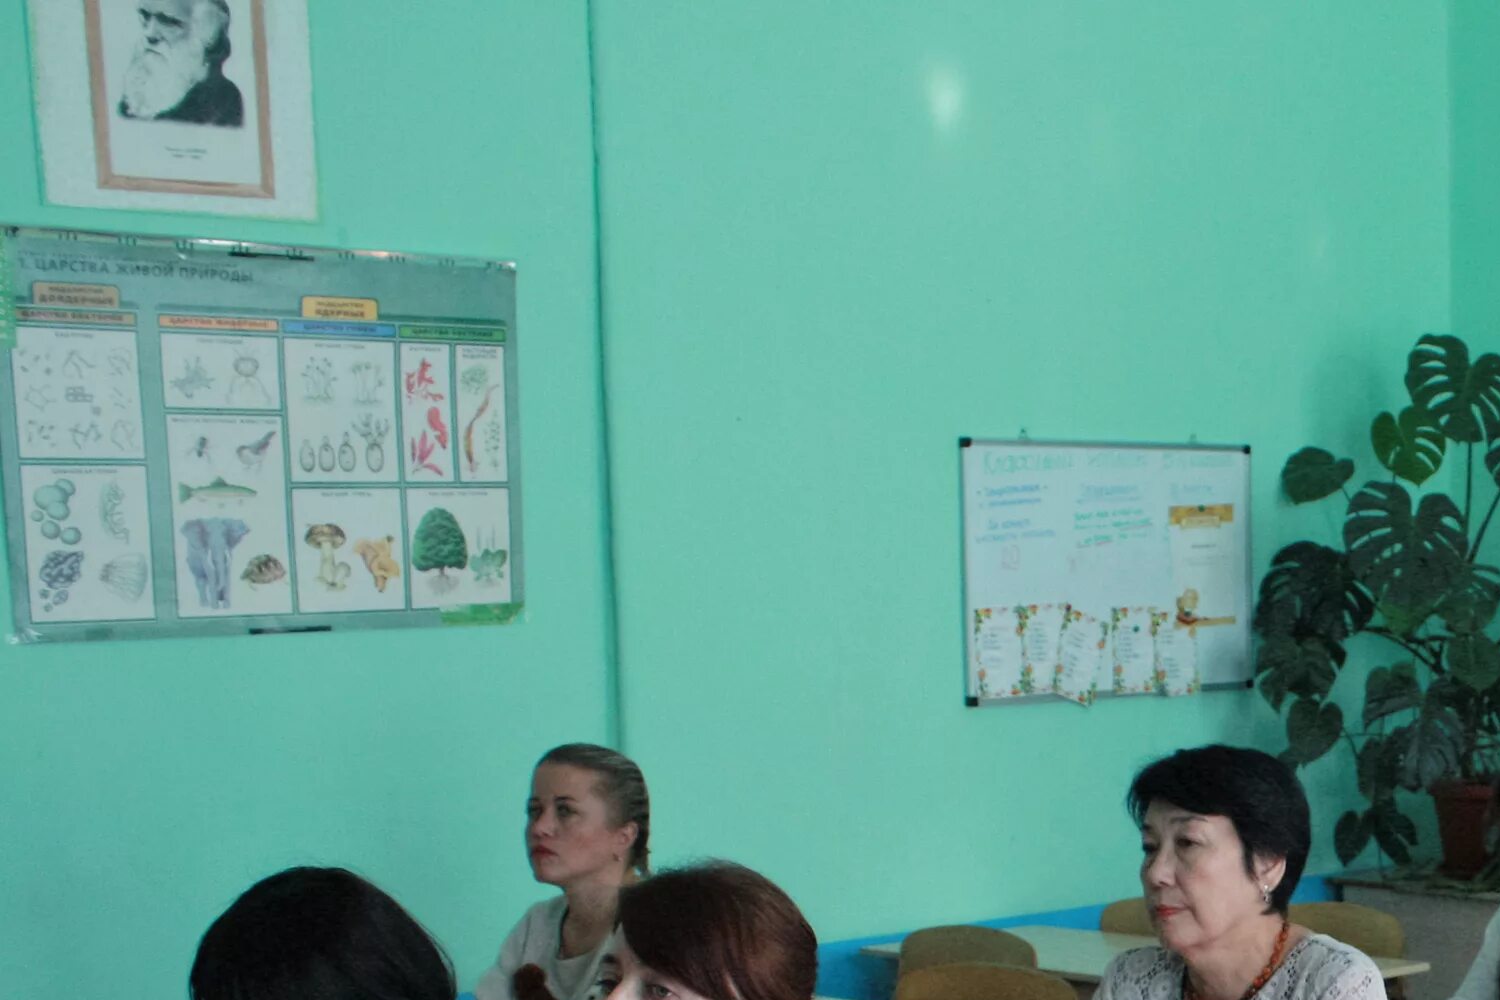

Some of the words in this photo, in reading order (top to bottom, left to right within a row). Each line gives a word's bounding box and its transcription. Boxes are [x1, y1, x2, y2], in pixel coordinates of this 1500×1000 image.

[34, 259, 109, 276] ЦАРСТВА
[115, 260, 175, 278] ЖИВОЙ
[178, 266, 254, 282] ПРИРОДЫ
